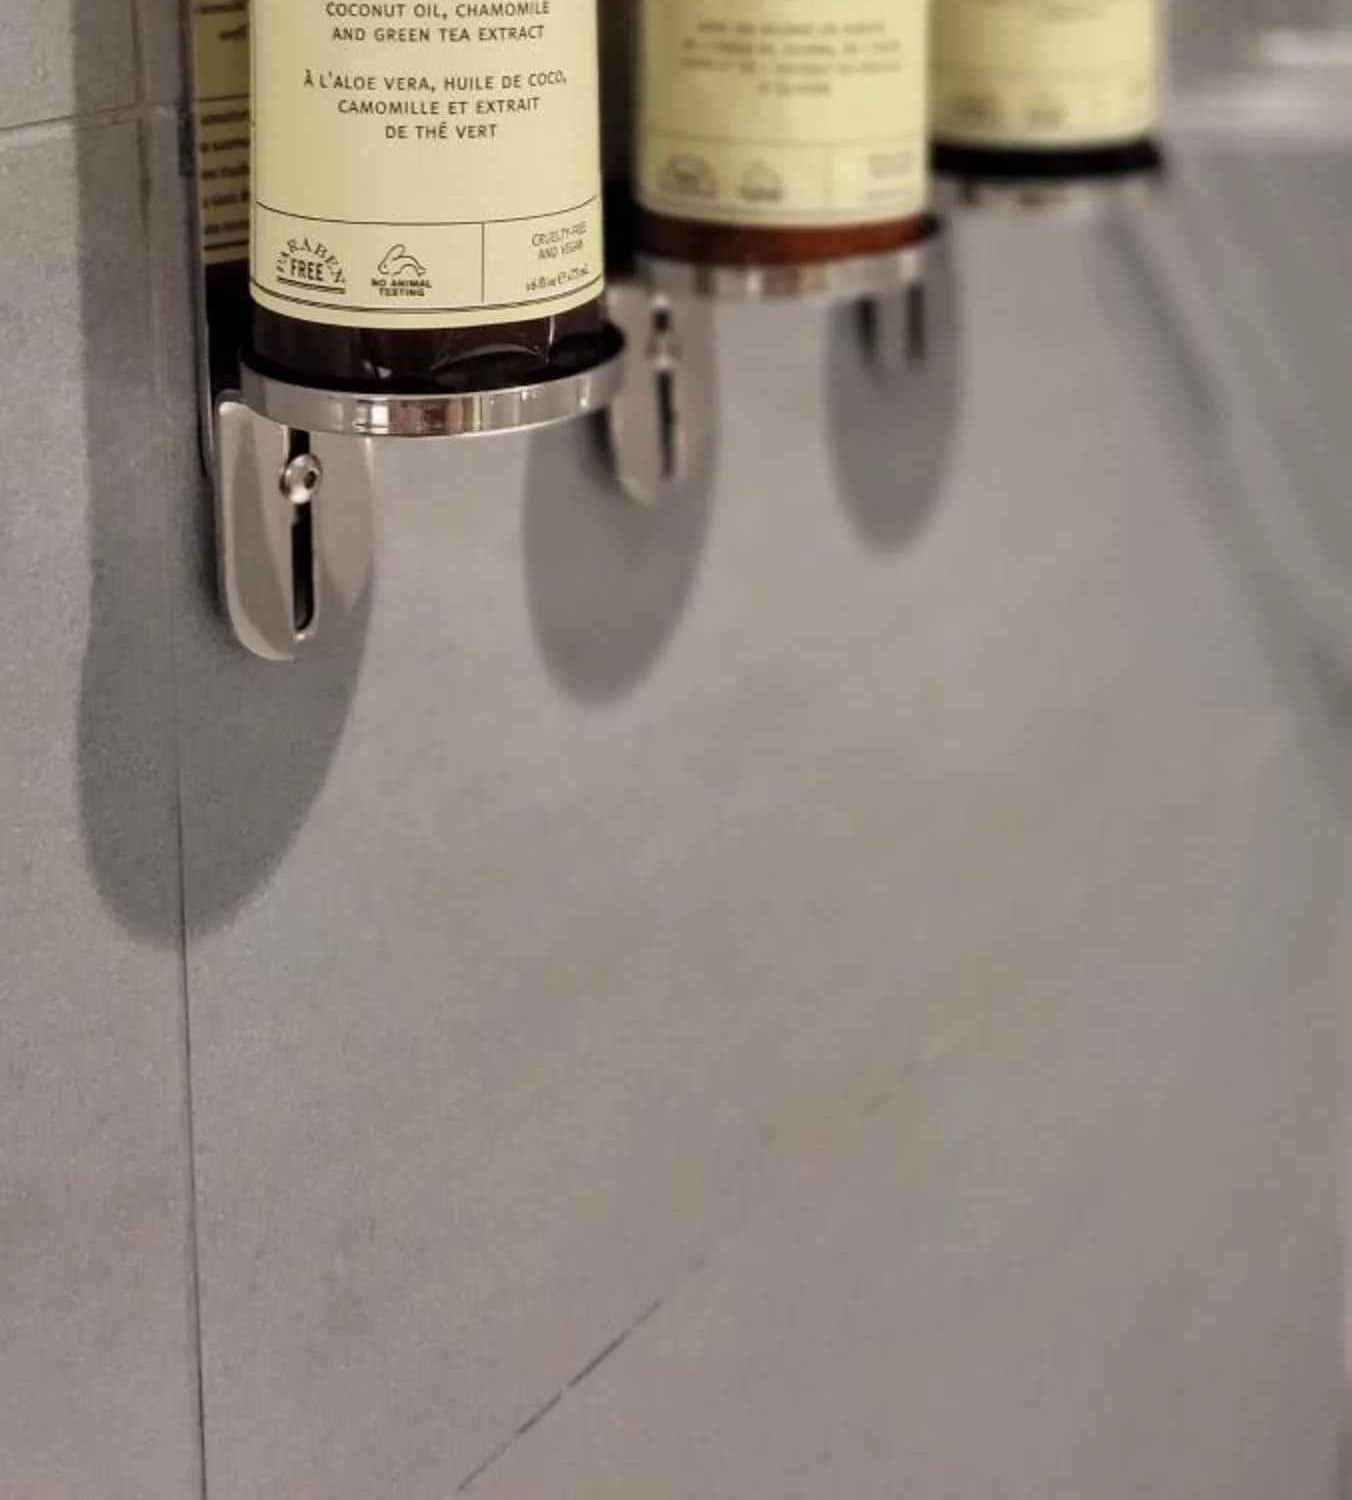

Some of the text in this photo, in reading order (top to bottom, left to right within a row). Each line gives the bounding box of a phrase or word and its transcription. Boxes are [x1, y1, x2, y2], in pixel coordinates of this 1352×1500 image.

[325, 0, 550, 20] COCONUT OIL, CHAMOMILE
[331, 25, 545, 42] AND GREEN TEA EXTRACT
[319, 70, 377, 91] L'ALOE
[384, 76, 435, 93] VERA,
[444, 75, 494, 91] HUILE
[501, 74, 523, 89] DE
[527, 69, 567, 88] COCO,
[338, 97, 540, 115] CAMOMILLE ET EXTRAIT
[385, 121, 498, 140] DE THÉ VERT
[290, 258, 324, 282] FREE
[371, 278, 432, 288] NO ANIMAL
[379, 287, 425, 297] TESTING
